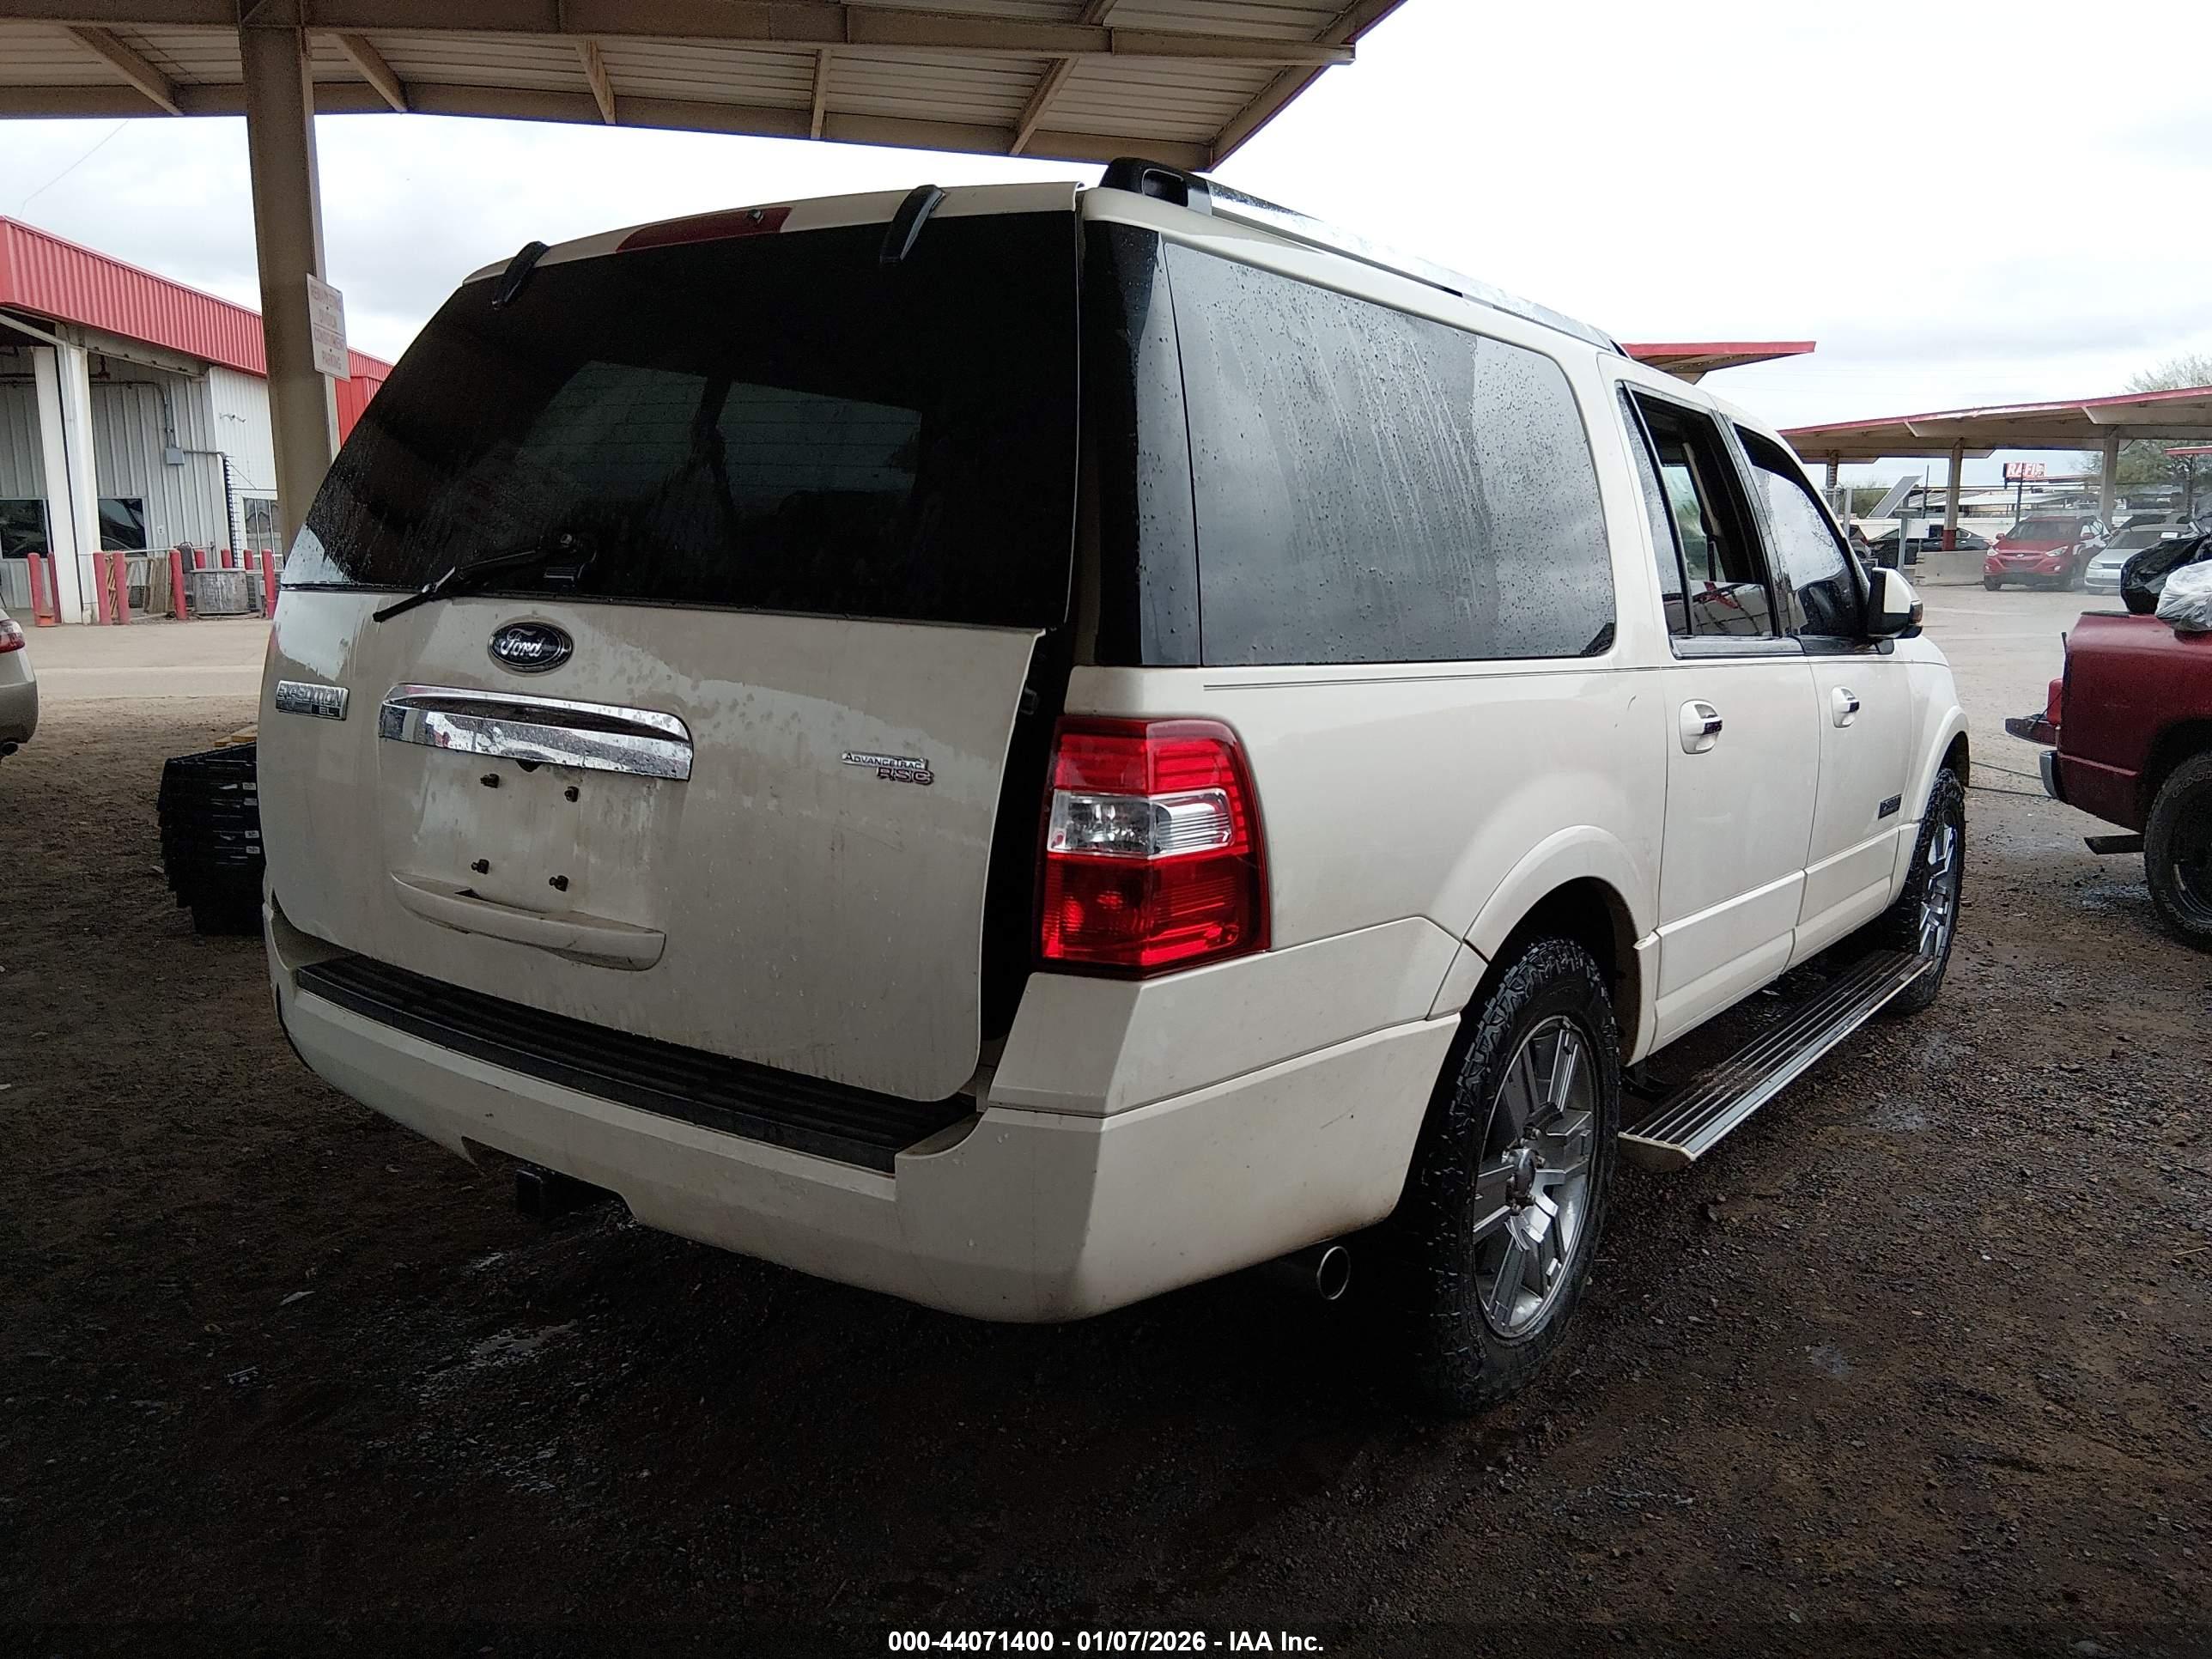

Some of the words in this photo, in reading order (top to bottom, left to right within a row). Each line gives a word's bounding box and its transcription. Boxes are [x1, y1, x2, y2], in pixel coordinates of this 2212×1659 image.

[500, 628, 546, 657] Ford
[319, 706, 335, 716] EL
[877, 767, 934, 786] RSC
